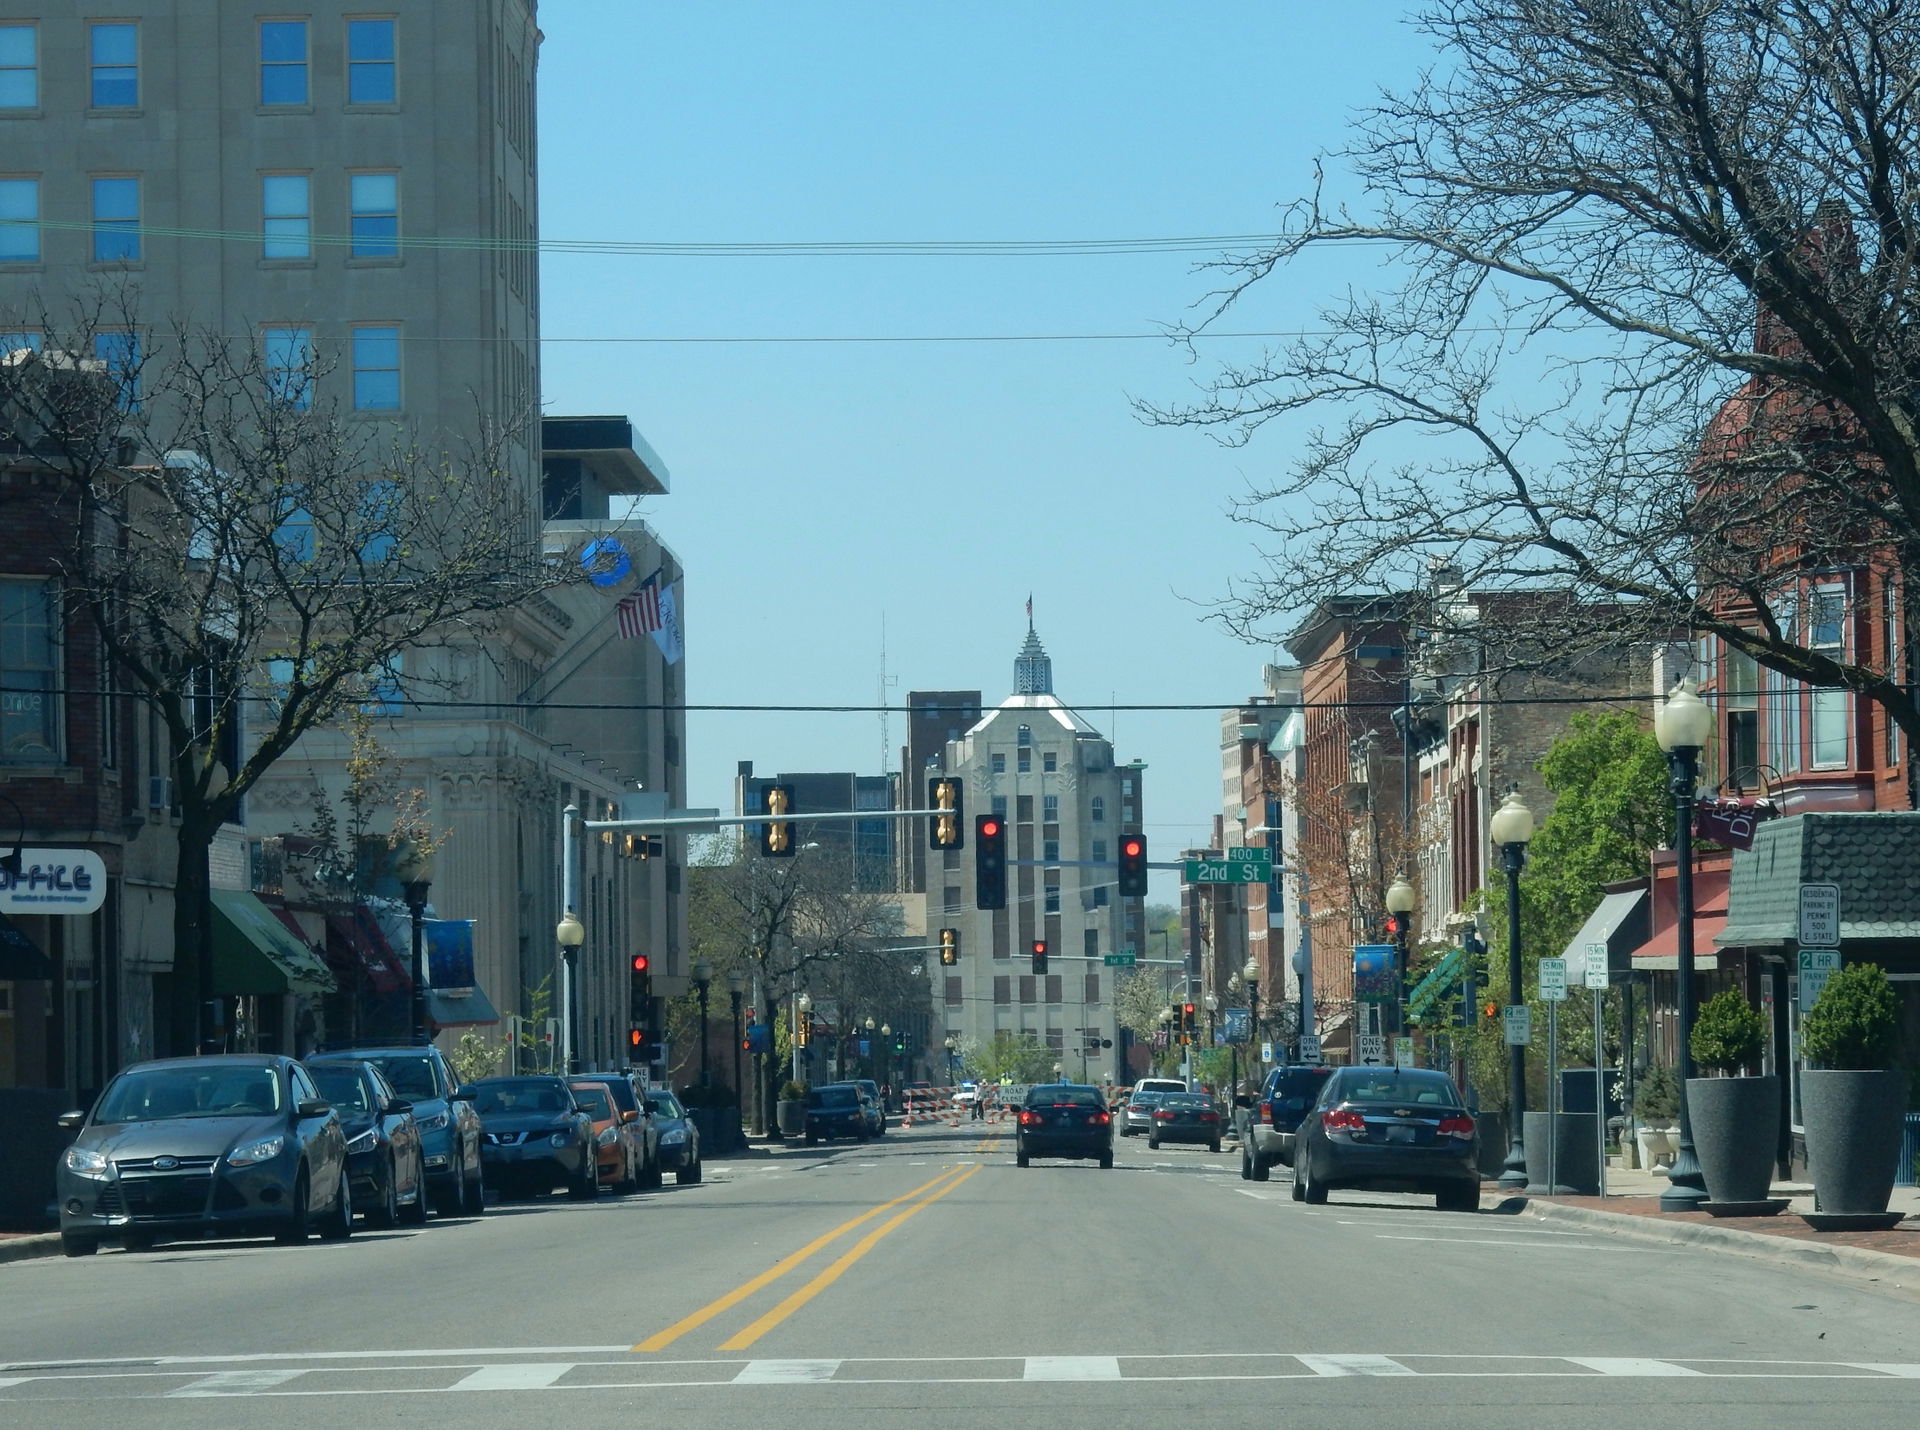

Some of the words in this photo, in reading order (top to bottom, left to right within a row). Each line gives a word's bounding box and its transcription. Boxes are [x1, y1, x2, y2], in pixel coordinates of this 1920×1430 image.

[1230, 848, 1252, 860] 400
[1262, 848, 1270, 860] E
[1197, 862, 1228, 881] 2nd
[1242, 863, 1260, 881] St
[1803, 901, 1825, 909] PARKING
[1806, 912, 1831, 920] PERMIT
[1811, 922, 1826, 930] 500
[1812, 932, 1833, 940] STATE
[1801, 953, 1811, 968] 2
[1817, 955, 1832, 967] HR
[1551, 961, 1564, 970] MIN
[1804, 972, 1828, 980] PARKI
[1302, 1037, 1318, 1045] ONE
[1361, 1037, 1380, 1046] ONE
[1302, 1045, 1318, 1053] WAY
[1361, 1046, 1381, 1055] WAY
